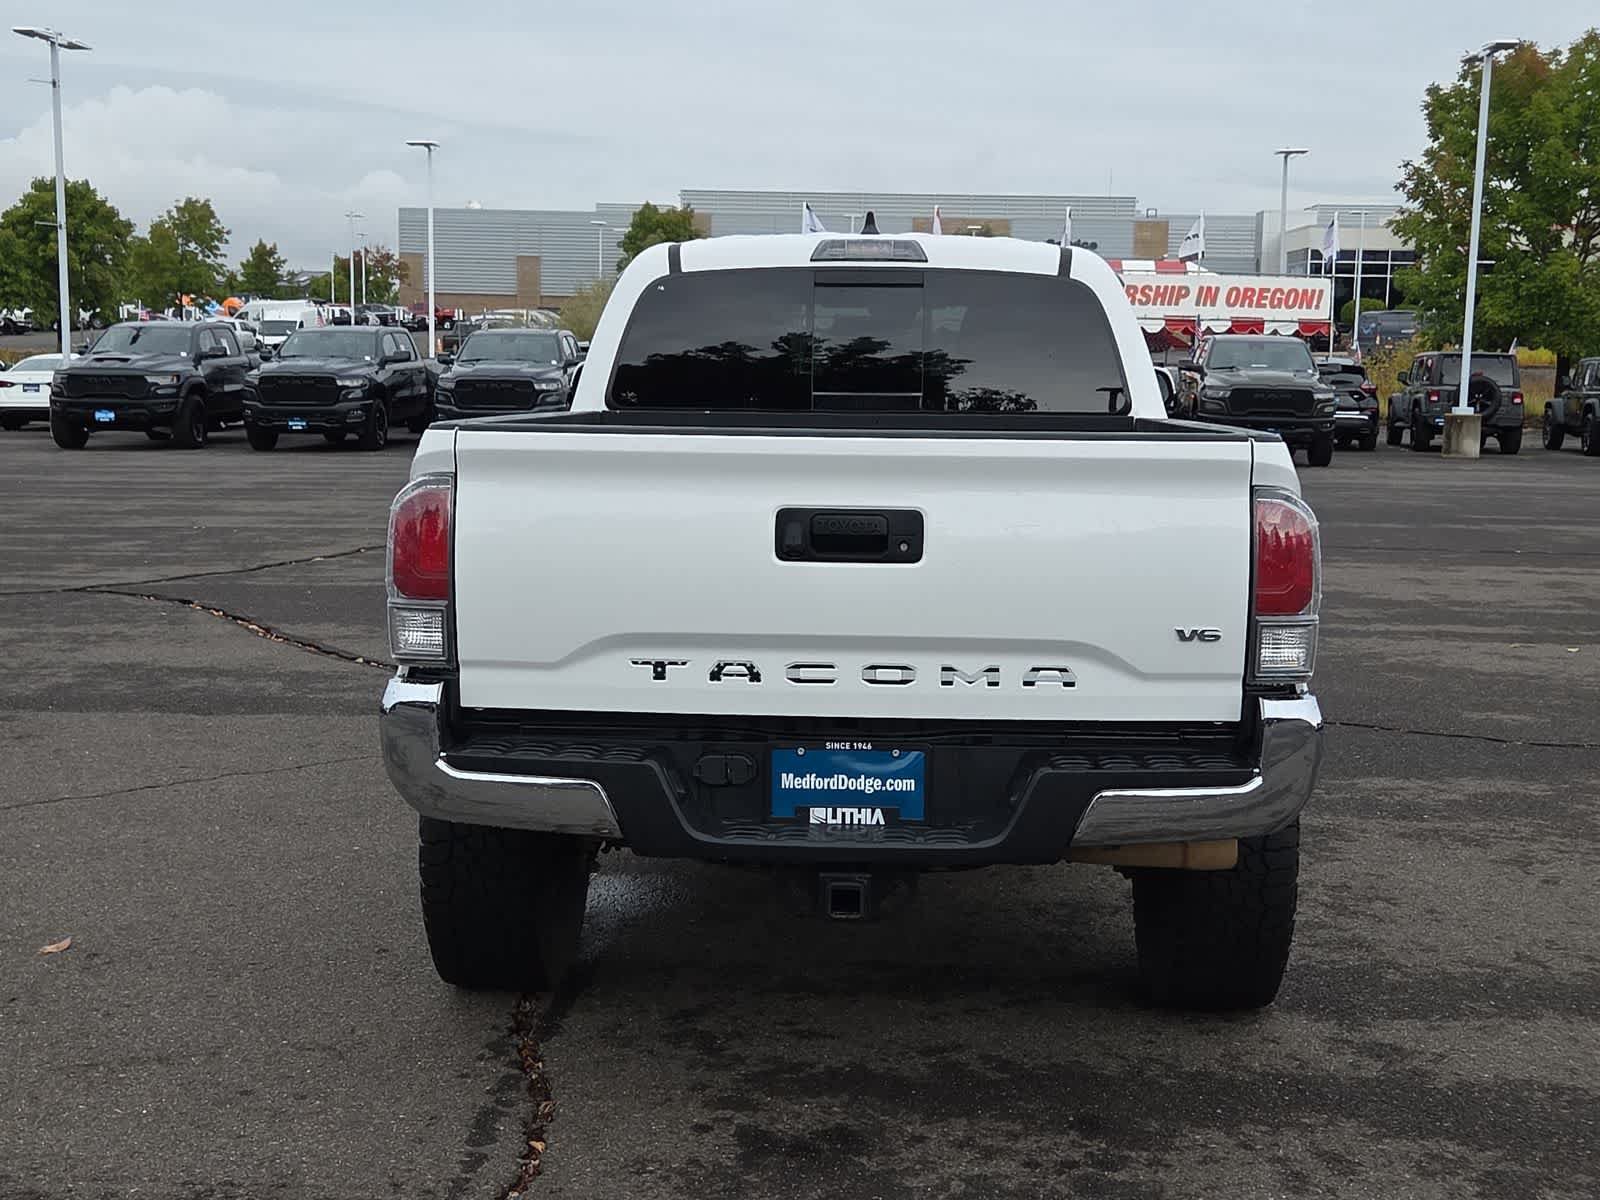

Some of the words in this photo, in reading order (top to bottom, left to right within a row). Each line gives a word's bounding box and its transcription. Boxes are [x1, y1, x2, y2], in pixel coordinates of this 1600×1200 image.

[1194, 285, 1221, 307] IN
[1225, 286, 1325, 310] OREGON!
[816, 519, 881, 531] TOYOTA
[1174, 627, 1222, 642] V6
[629, 658, 1078, 688] TACOMA
[825, 742, 851, 750] SINCE
[853, 742, 873, 750] 1946
[781, 772, 916, 794] MedfordDodge.com
[827, 807, 886, 825] LITHIA
